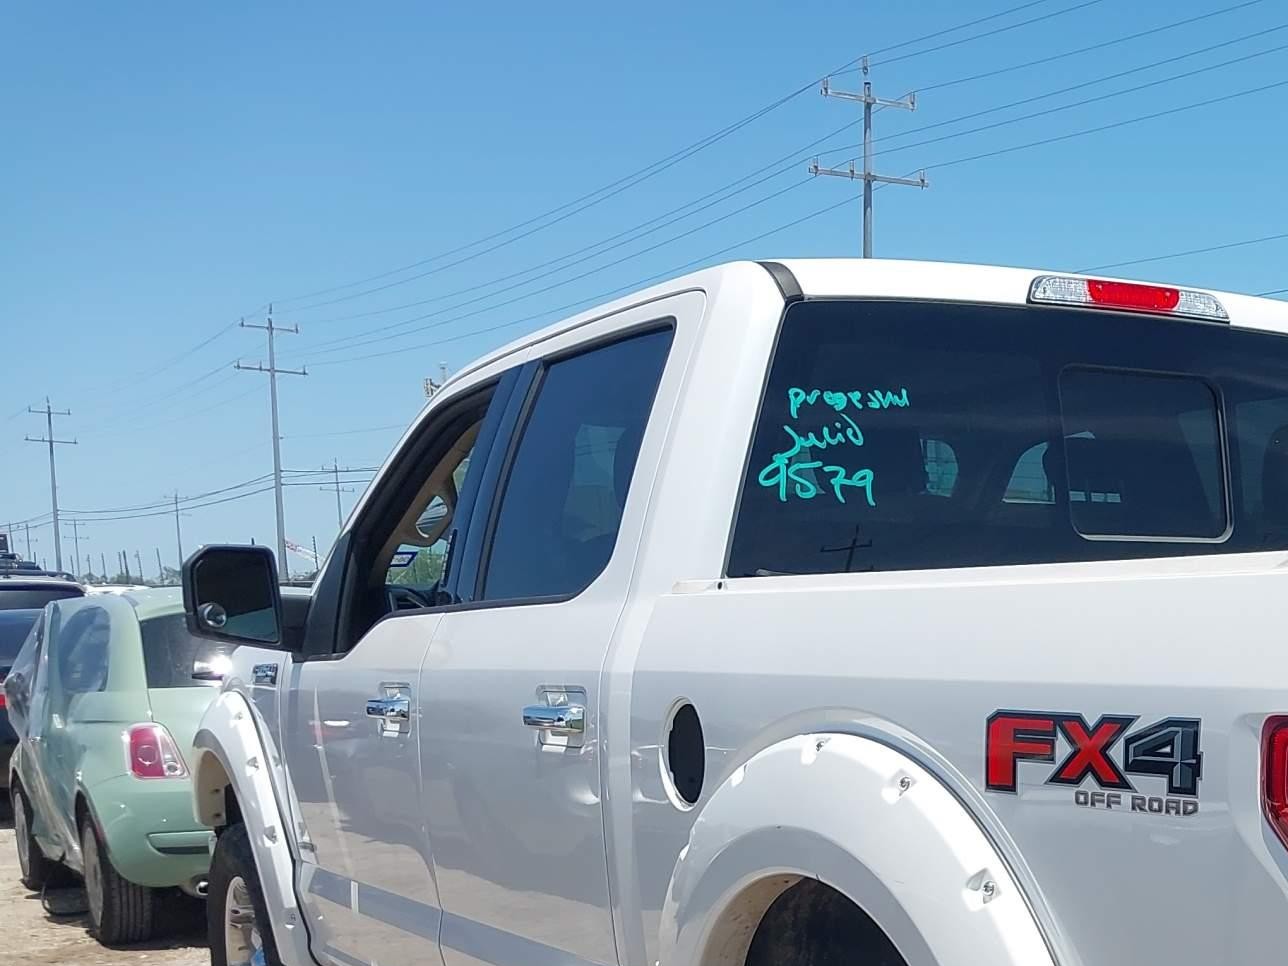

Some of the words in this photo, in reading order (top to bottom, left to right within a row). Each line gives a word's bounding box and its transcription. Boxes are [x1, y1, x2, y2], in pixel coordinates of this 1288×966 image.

[758, 459, 876, 507] 9579
[985, 708, 1203, 798] FX4
[1074, 790, 1122, 809] OFF
[1131, 795, 1199, 816] ROAD
